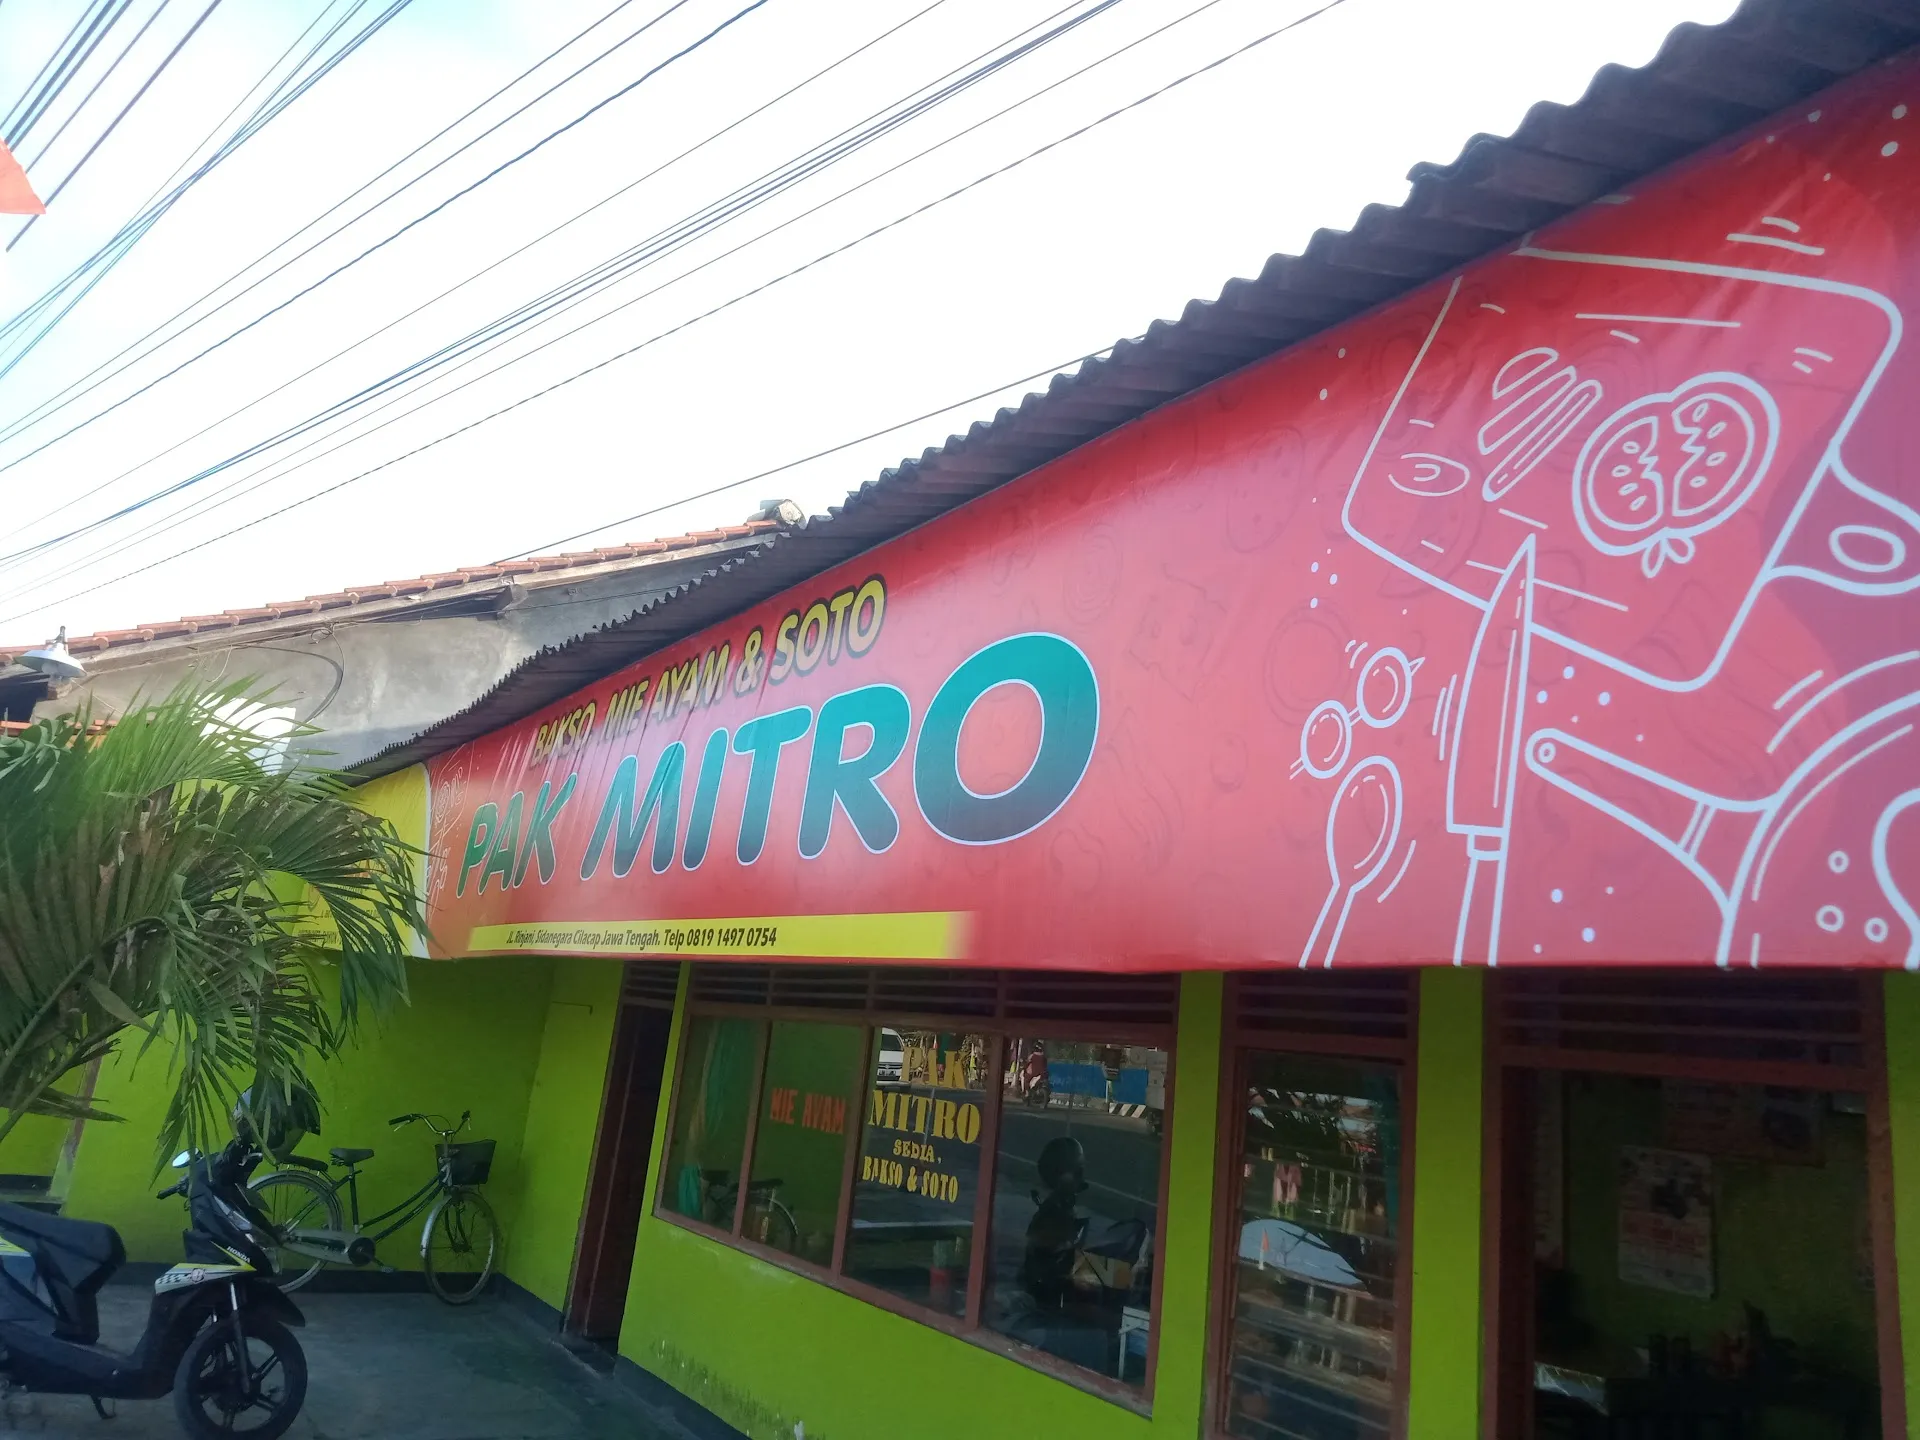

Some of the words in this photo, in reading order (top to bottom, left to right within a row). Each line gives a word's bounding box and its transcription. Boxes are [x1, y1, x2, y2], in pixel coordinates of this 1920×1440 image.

[602, 678, 651, 740] MIE
[651, 643, 732, 722] AYAM
[734, 628, 765, 697] &
[769, 575, 887, 684] SOTO
[456, 773, 578, 899] PAK
[580, 632, 1100, 881] MITRO
[535, 930, 573, 948] Sidanegara
[573, 930, 600, 949] Cilacap
[601, 930, 623, 946] Jawa
[624, 929, 661, 951] Tengah.
[663, 929, 685, 951] Telp
[686, 928, 714, 946] 0819
[717, 928, 745, 946] 1497
[746, 927, 777, 947] 0754
[900, 1046, 969, 1090] PAK
[802, 1093, 846, 1134] AYAM
[868, 1089, 981, 1144] MITRO
[862, 1156, 903, 1188] BAKSO
[906, 1166, 918, 1192] &
[921, 1170, 959, 1203] SOTO
[227, 1246, 250, 1263] HONDA
